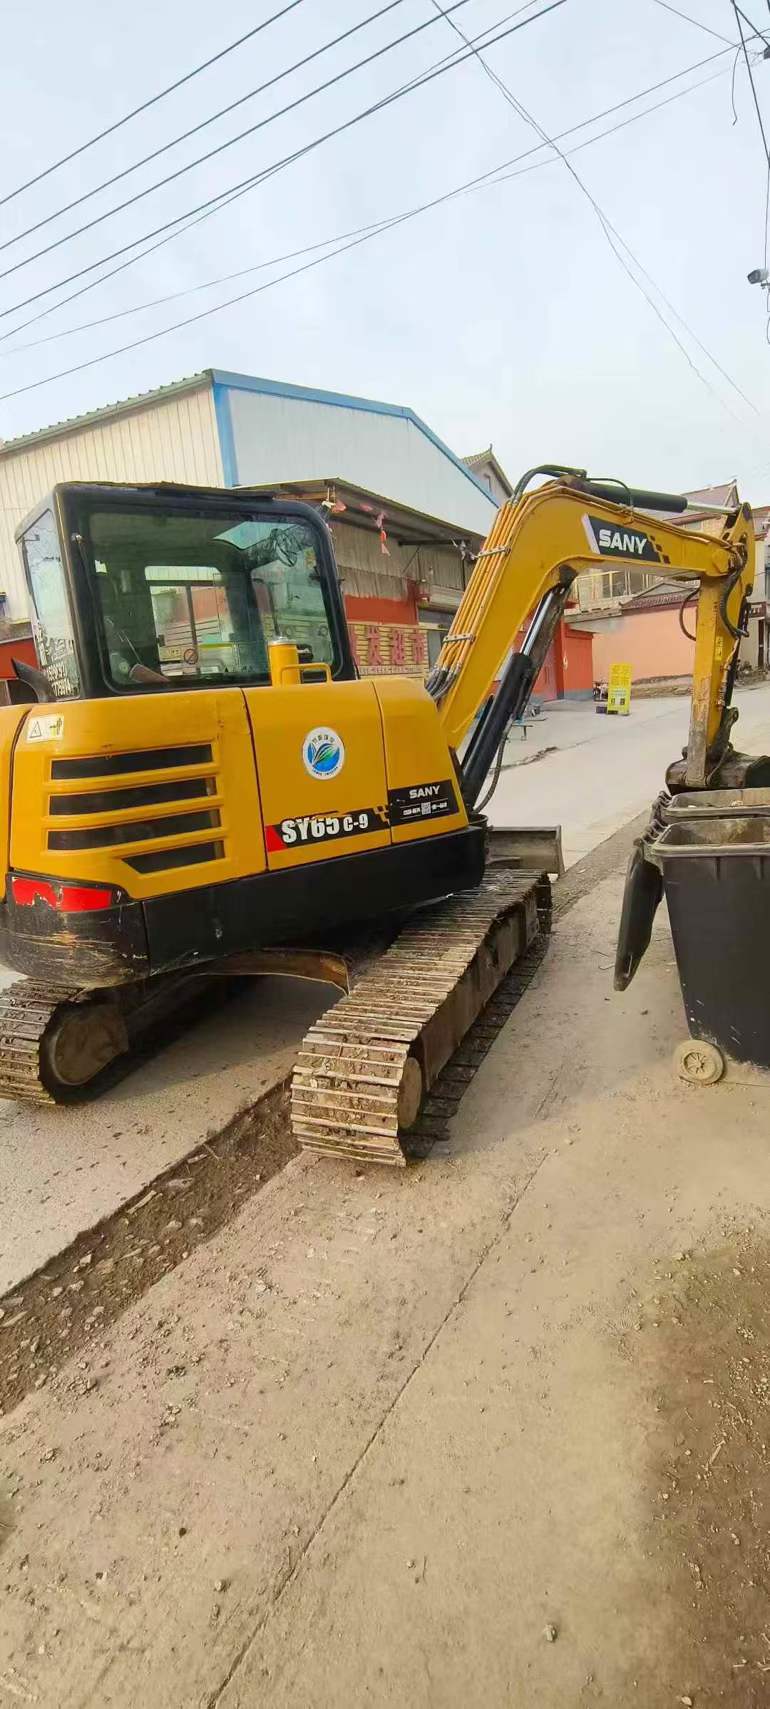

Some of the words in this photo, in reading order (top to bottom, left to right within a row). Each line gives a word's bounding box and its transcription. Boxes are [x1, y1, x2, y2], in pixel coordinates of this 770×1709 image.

[599, 528, 647, 554] SANY
[409, 784, 440, 799] SANY
[281, 816, 340, 843] SY65
